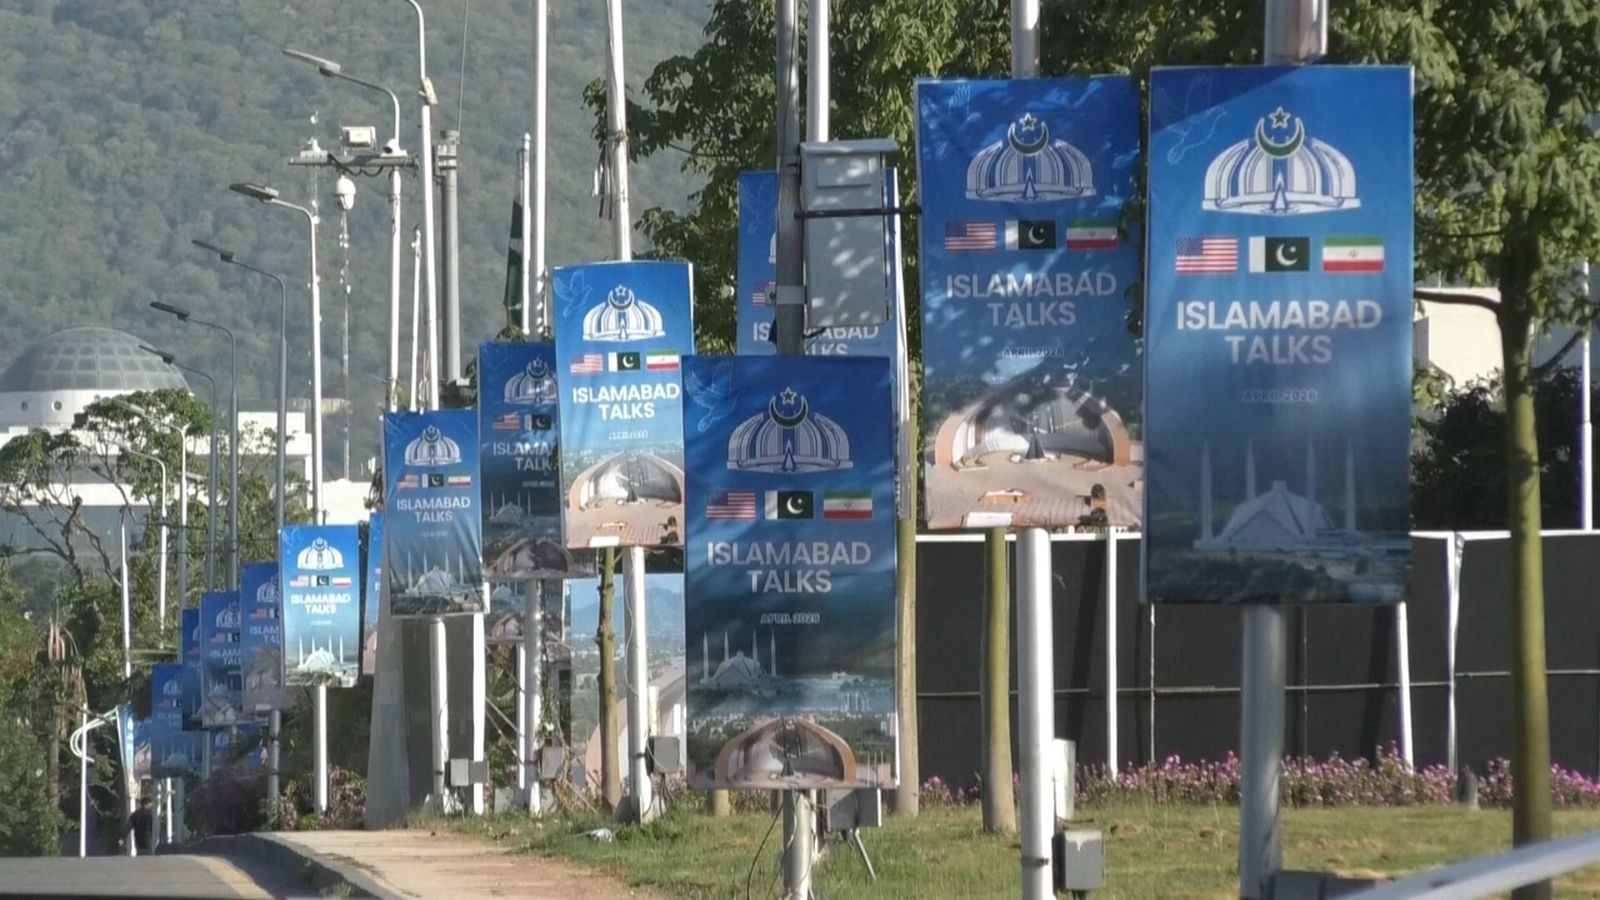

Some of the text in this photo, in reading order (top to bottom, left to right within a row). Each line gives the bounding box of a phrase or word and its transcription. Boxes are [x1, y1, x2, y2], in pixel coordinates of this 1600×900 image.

[946, 273, 1117, 299] ISLAMABAD
[987, 301, 1076, 326] TALKS
[1178, 300, 1382, 330] ISLAMABAD
[1225, 335, 1331, 364] TALKS
[572, 383, 680, 403] ISLAMABAD
[599, 403, 656, 420] TALKS
[514, 457, 552, 471] TALK
[397, 496, 471, 510] ISLAMABAD
[414, 510, 453, 523] TALKS
[707, 542, 871, 566] ISLAMABAD
[747, 569, 832, 593] TALKS
[291, 593, 351, 604] ISLAMABAD
[305, 603, 337, 614] TALKS
